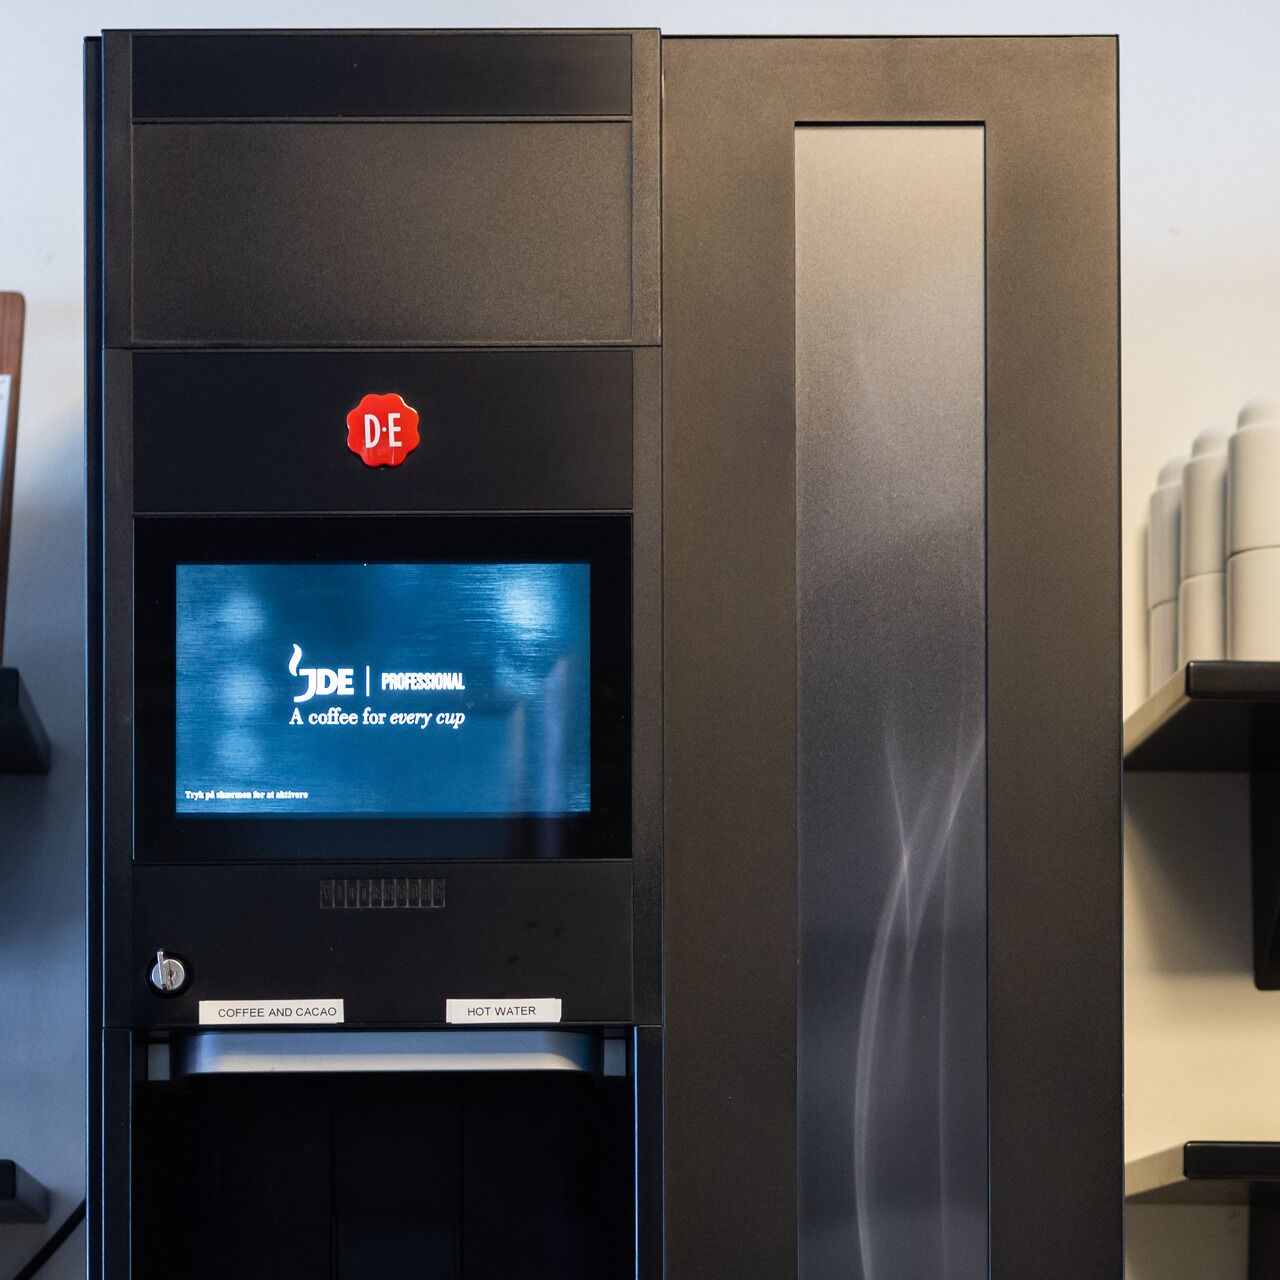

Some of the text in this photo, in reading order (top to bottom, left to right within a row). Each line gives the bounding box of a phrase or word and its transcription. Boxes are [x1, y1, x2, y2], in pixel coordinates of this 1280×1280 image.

[293, 668, 466, 703] JDE PROFESSIONAL
[289, 706, 466, 729] A coffee for every cup
[184, 791, 205, 801] Tryk
[205, 790, 215, 801] på
[253, 790, 265, 799] for
[217, 1007, 337, 1018] COFFEE AND CACAO
[467, 1005, 536, 1017] HOT WATER
